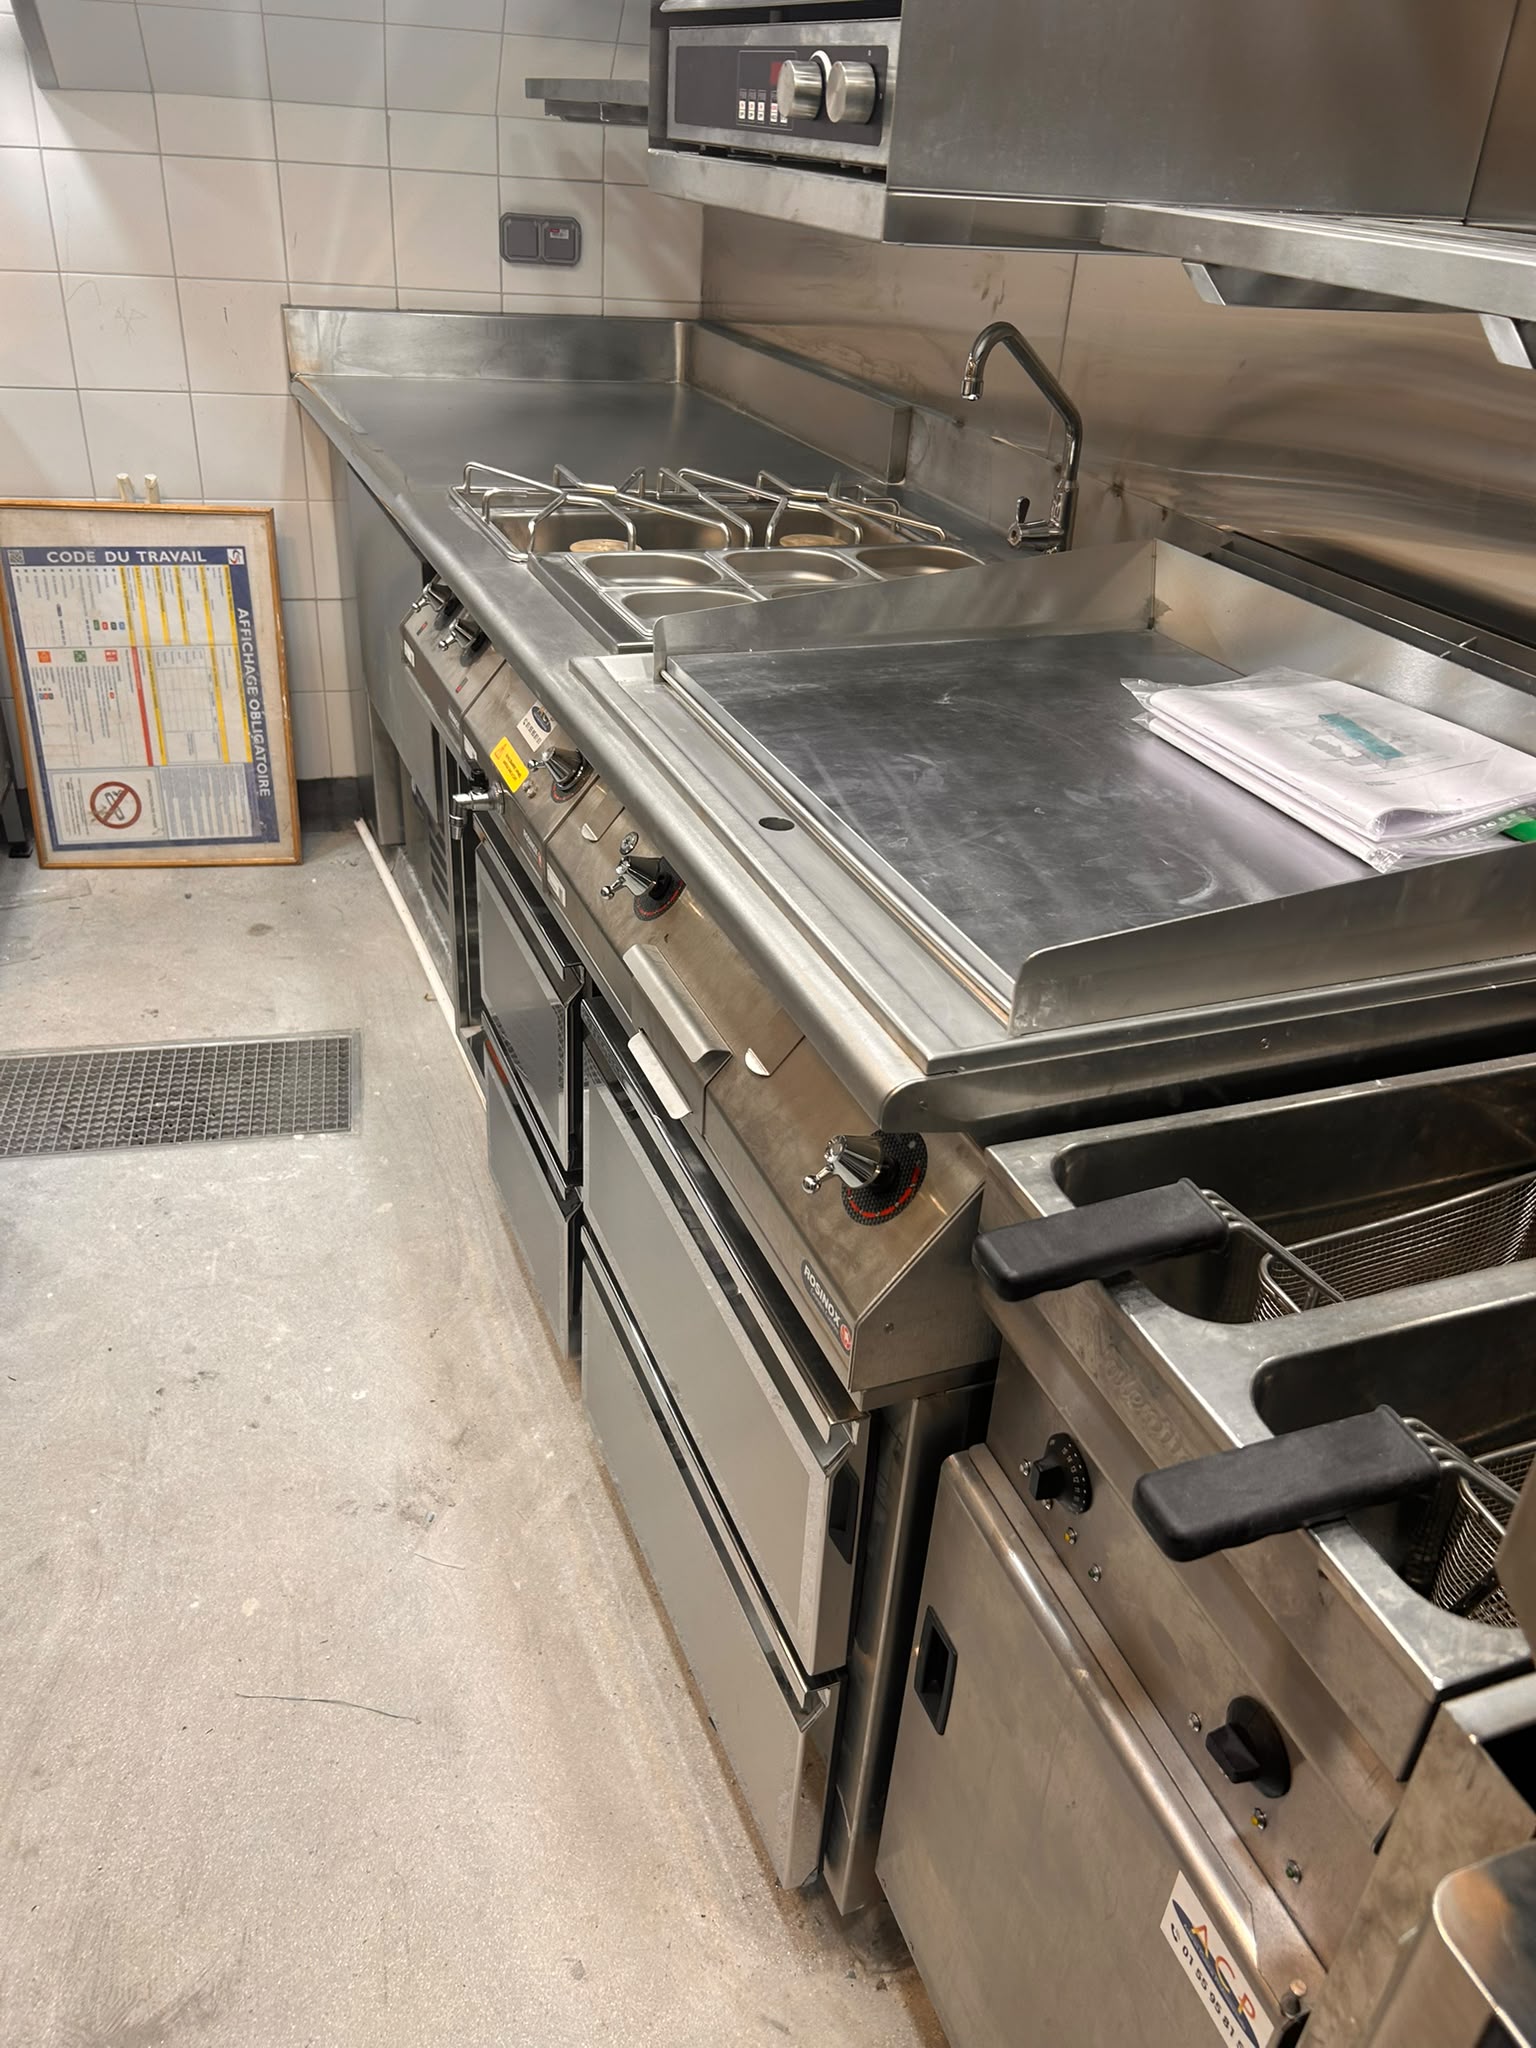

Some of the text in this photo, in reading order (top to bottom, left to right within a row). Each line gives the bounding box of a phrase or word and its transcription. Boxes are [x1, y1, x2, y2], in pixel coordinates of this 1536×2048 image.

[46, 551, 208, 564] CODE DU TRAVAIL
[237, 608, 271, 798] AFFICHAGE OBLIGATOIRE
[803, 1264, 840, 1327] ROSINOX
[1182, 1945, 1194, 1966] 01
[1195, 1968, 1208, 1991] 55
[1222, 2015, 1235, 2037] 81
